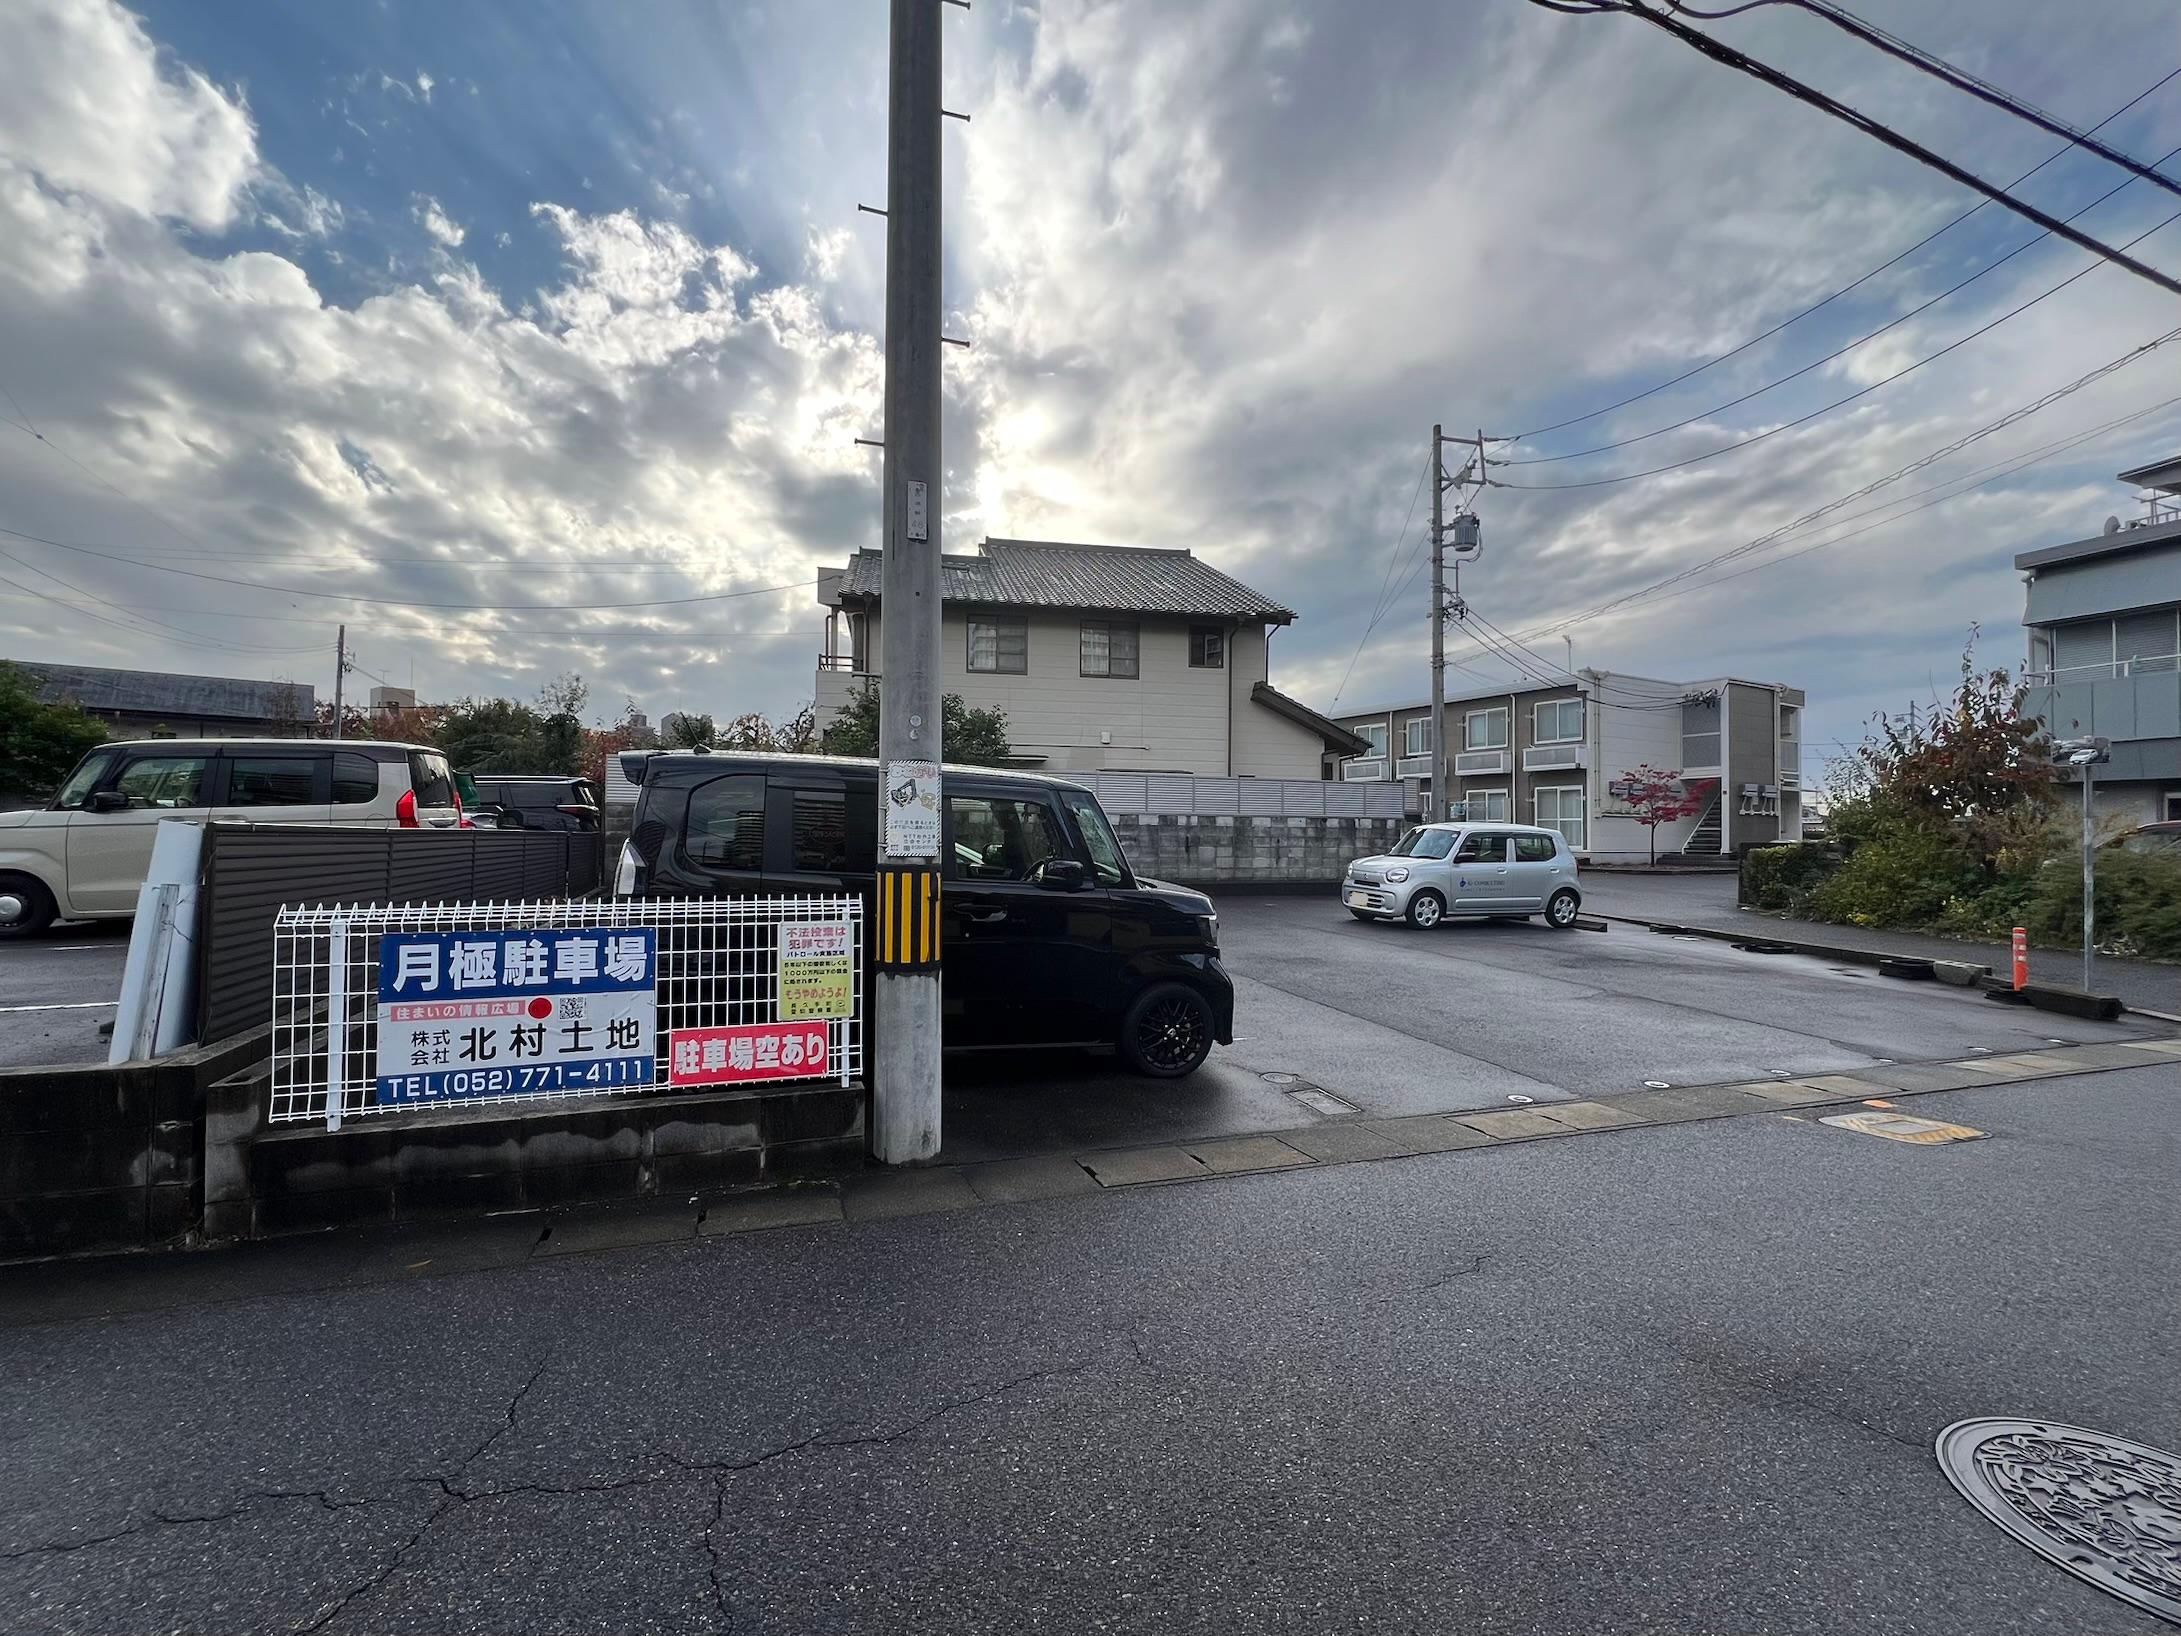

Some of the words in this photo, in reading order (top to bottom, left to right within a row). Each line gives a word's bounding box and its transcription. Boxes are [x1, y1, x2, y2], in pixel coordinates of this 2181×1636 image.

[786, 926, 846, 938] 不法投棄は
[393, 936, 647, 992] 月極駐車場
[397, 1005, 520, 1020] 住まいの情報広場
[459, 1017, 640, 1062] 北村土地
[674, 1032, 825, 1076] 駐車場空あり
